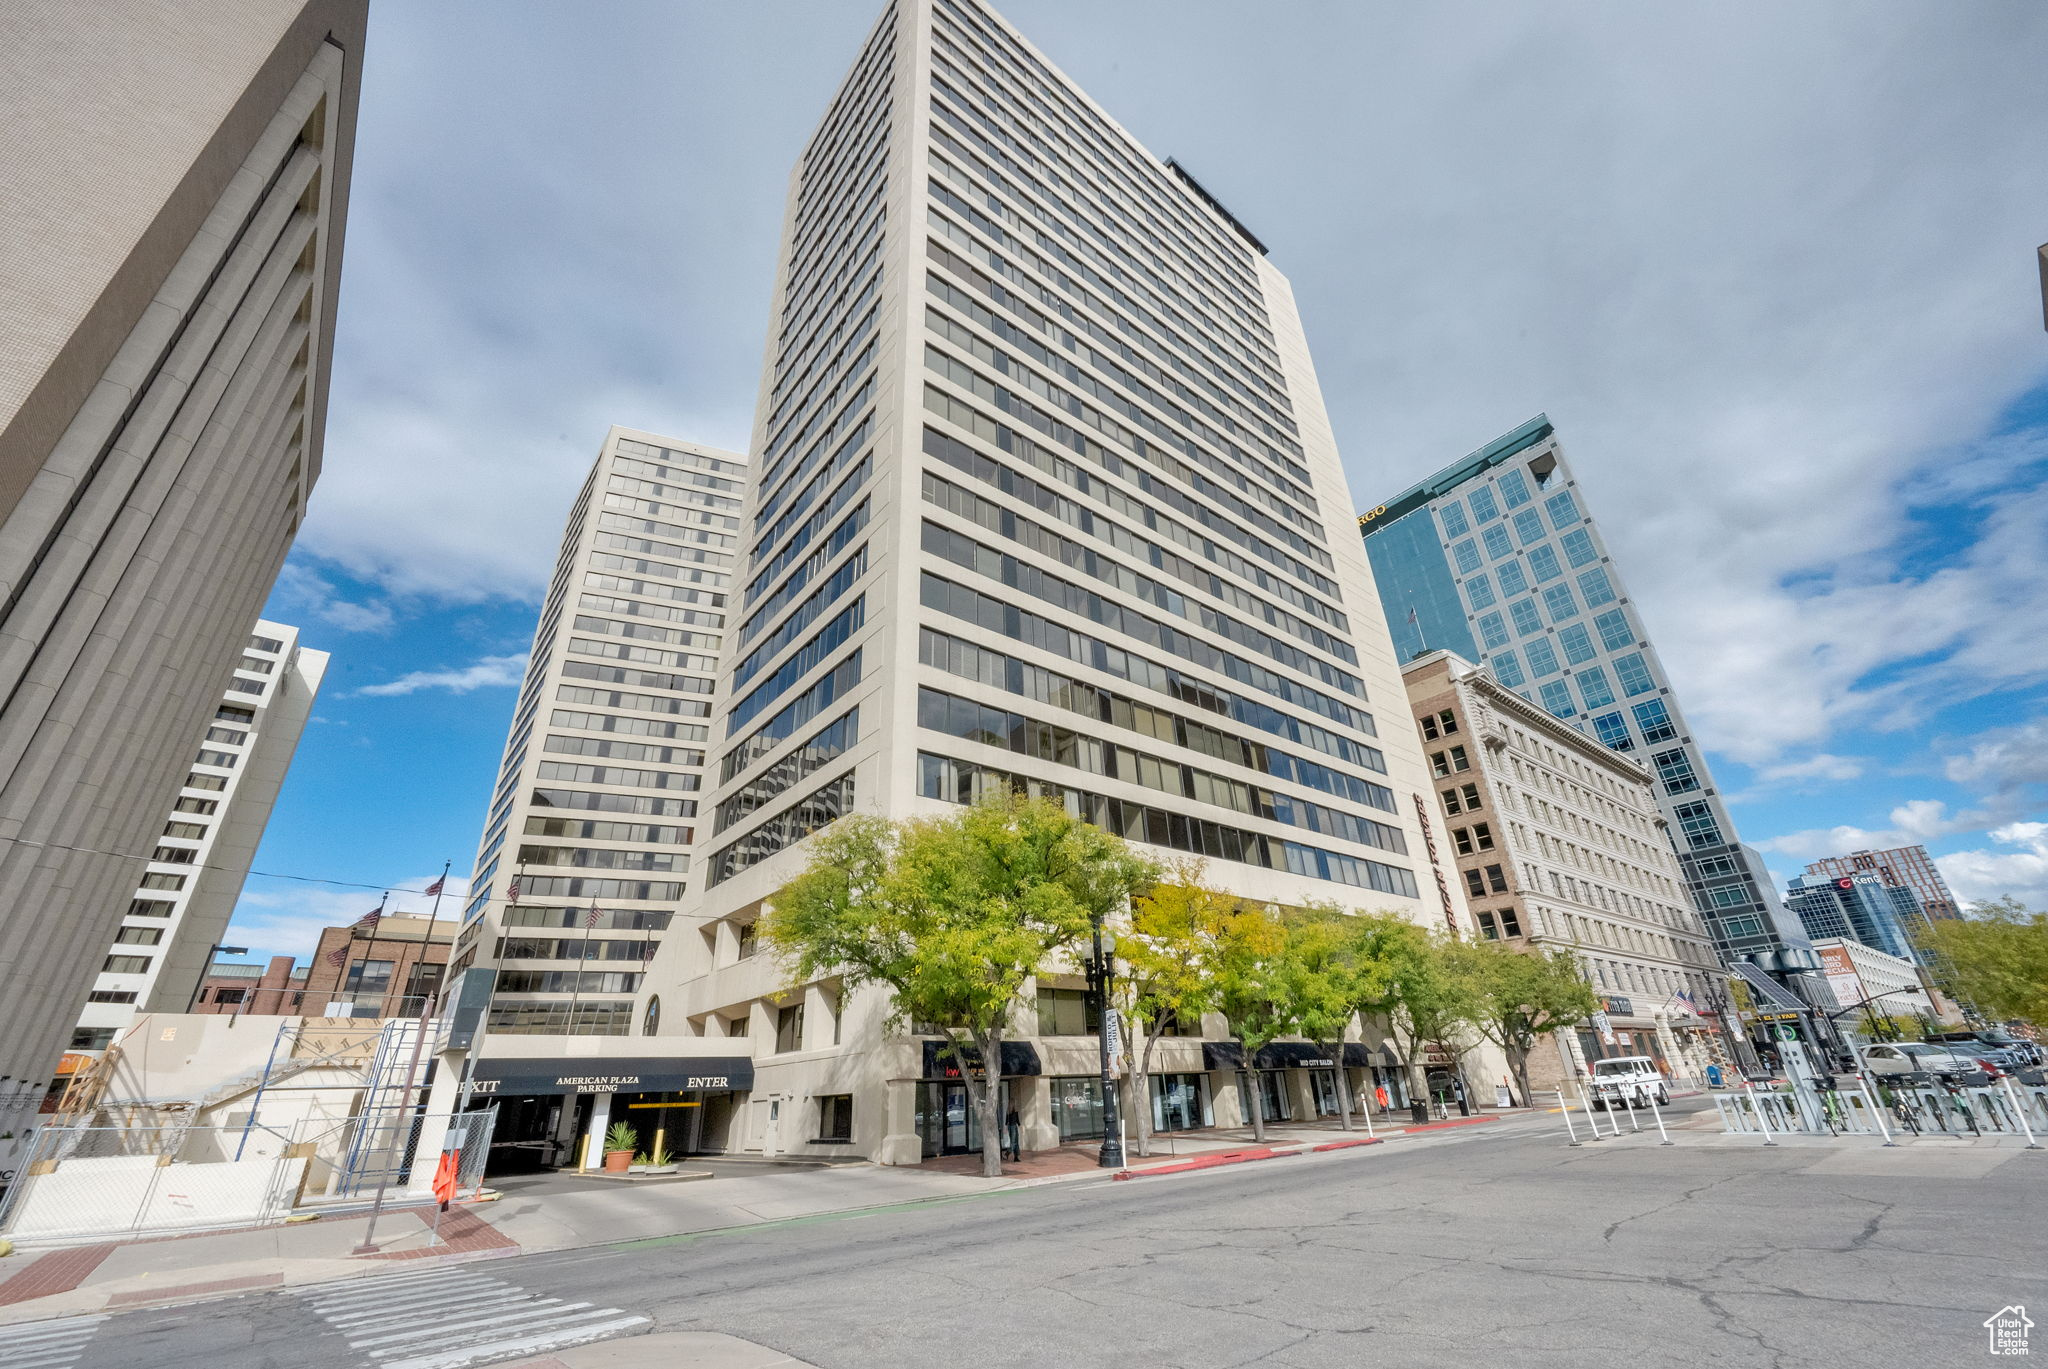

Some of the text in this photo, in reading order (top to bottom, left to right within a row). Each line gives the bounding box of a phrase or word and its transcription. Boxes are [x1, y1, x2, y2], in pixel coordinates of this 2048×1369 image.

[1356, 505, 1386, 526] RGO
[1413, 792, 1439, 865] TOWERS
[946, 1066, 960, 1077] kw
[556, 1076, 640, 1085] AMERICAN PLAZA
[687, 1077, 729, 1088] ENTER
[577, 1084, 618, 1093] PARKING
